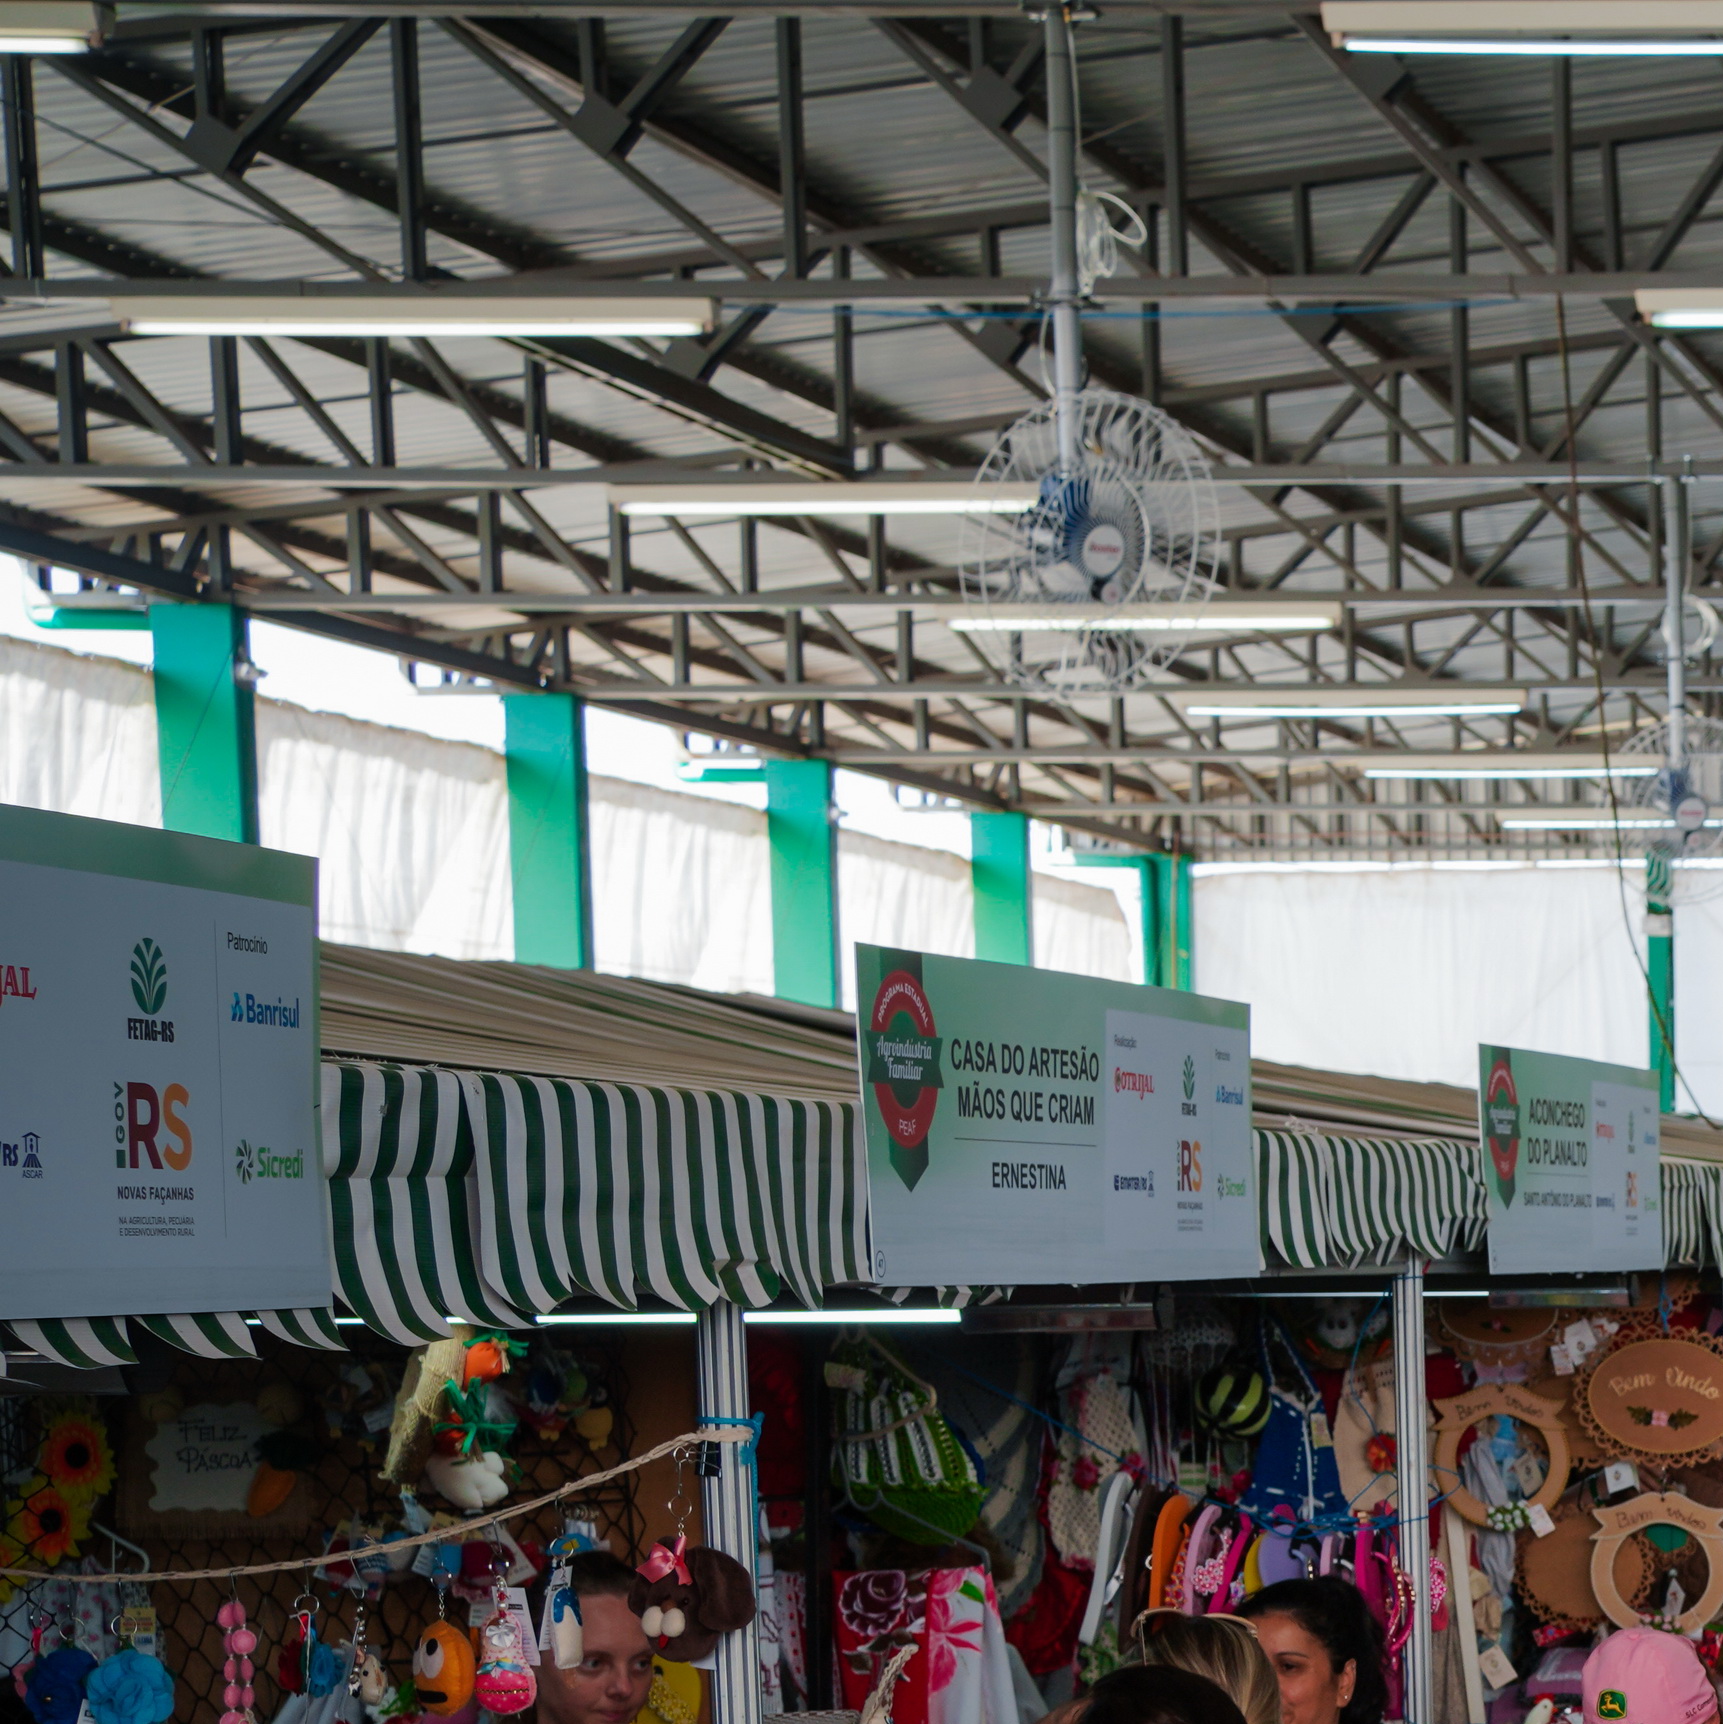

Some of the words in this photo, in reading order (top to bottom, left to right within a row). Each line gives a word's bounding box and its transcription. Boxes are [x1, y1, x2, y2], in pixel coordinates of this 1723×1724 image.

[227, 931, 268, 954] Patrocínio
[0, 964, 37, 1004] AL
[246, 993, 299, 1029] Banrisul
[877, 983, 904, 1023] PROGRAMA
[904, 983, 929, 1028] ESTADUAL
[127, 1017, 175, 1043] FETAG-RS
[876, 1035, 932, 1062] Agroindústria
[951, 1038, 996, 1074] CASA
[1001, 1044, 1025, 1076] DO
[1028, 1045, 1100, 1082] ARTESÃO
[887, 1057, 924, 1081] Familiar
[957, 1080, 1005, 1119] MÃOS
[1011, 1091, 1044, 1123] QUE
[1048, 1096, 1094, 1125] CRIAM
[1529, 1098, 1585, 1129] ACONCHEGO
[127, 1081, 193, 1172] RS
[898, 1118, 917, 1137] PEAF
[257, 1146, 304, 1180] Sicredi
[1180, 1140, 1203, 1192] RS
[1527, 1137, 1541, 1164] DO
[1543, 1138, 1588, 1167] PLANALTO
[992, 1162, 1066, 1190] ERNESTINA
[117, 1186, 147, 1200] NOVAS
[149, 1186, 194, 1205] FAÇANHAS
[1609, 1371, 1656, 1397] Bem
